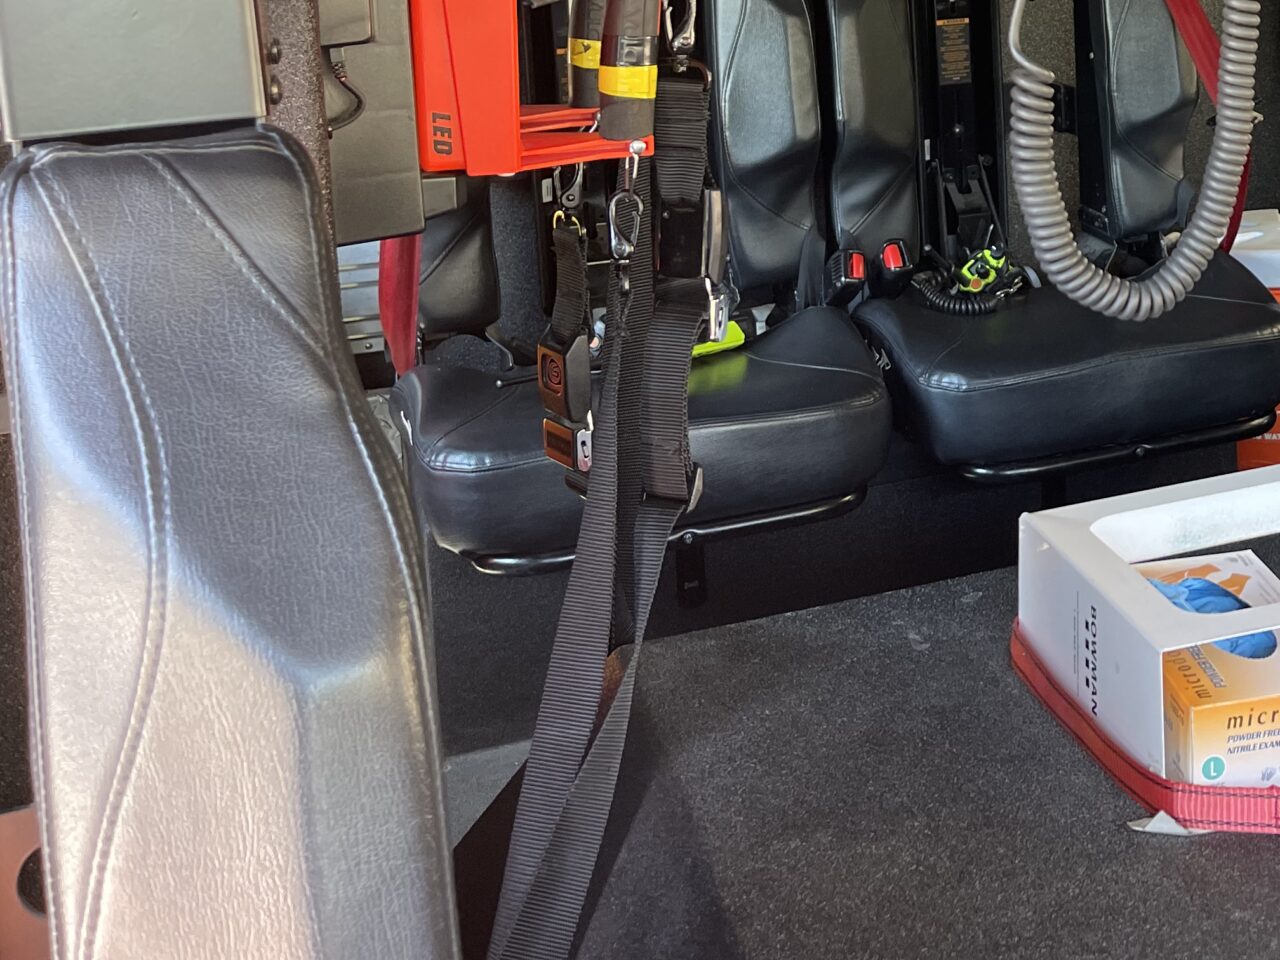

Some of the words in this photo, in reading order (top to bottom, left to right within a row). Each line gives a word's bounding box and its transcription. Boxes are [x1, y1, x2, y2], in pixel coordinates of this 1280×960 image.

[431, 112, 453, 156] LED
[1090, 605, 1098, 717] BOWMAN
[1165, 649, 1212, 699] microdo
[1227, 729, 1262, 743] POWDER
[1227, 741, 1258, 755] NITRILE
